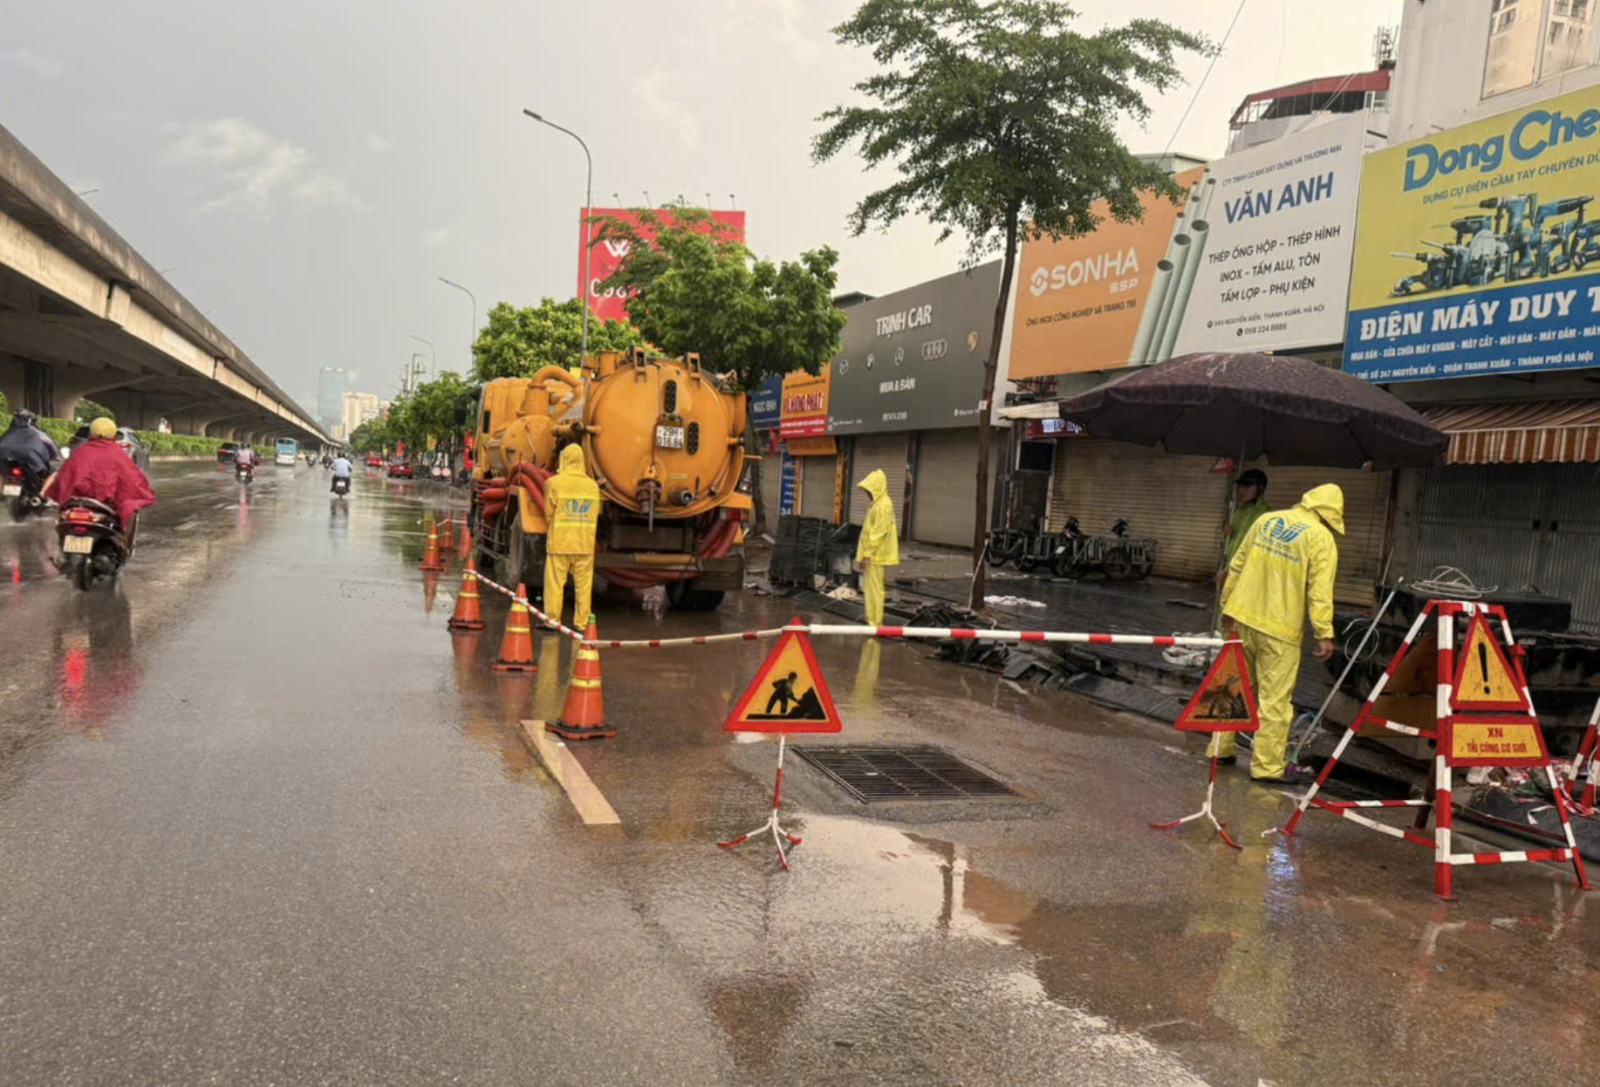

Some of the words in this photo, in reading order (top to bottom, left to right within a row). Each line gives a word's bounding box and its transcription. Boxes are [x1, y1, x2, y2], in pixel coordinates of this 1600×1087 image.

[1403, 135, 1505, 192] Dong
[1509, 109, 1600, 161] Che
[1224, 188, 1273, 224] VĂN
[1276, 171, 1335, 211] ANH
[1422, 189, 1449, 204] DỤNG
[1450, 186, 1464, 200] CỤ
[1516, 167, 1537, 182] TAY
[1538, 155, 1585, 176] CHUYÊN
[1208, 250, 1231, 265] THÉP
[1231, 243, 1254, 260] ỐNG
[1255, 238, 1278, 256] HỘP
[1286, 229, 1313, 247] THÉP
[1314, 225, 1341, 242] HÌNH
[1050, 246, 1140, 290] SONHA
[1109, 278, 1139, 294] SSP
[1219, 267, 1243, 283] INOX
[1252, 260, 1272, 278] TẤM
[1273, 258, 1295, 273] ALU,
[1298, 252, 1321, 267] TÔN
[1220, 287, 1240, 304] TẤM
[1241, 285, 1260, 302] LỢP
[1269, 280, 1290, 296] PHỤ
[1291, 276, 1315, 294] KIỆN
[875, 311, 907, 338] TRỊNH
[907, 304, 932, 328] CAR
[1360, 310, 1424, 341] ĐIỆN
[1431, 299, 1501, 332] MÁY
[1508, 289, 1578, 323] DUY
[1587, 286, 1600, 313] T
[1539, 330, 1557, 342] MÁY
[1487, 727, 1503, 738] XN
